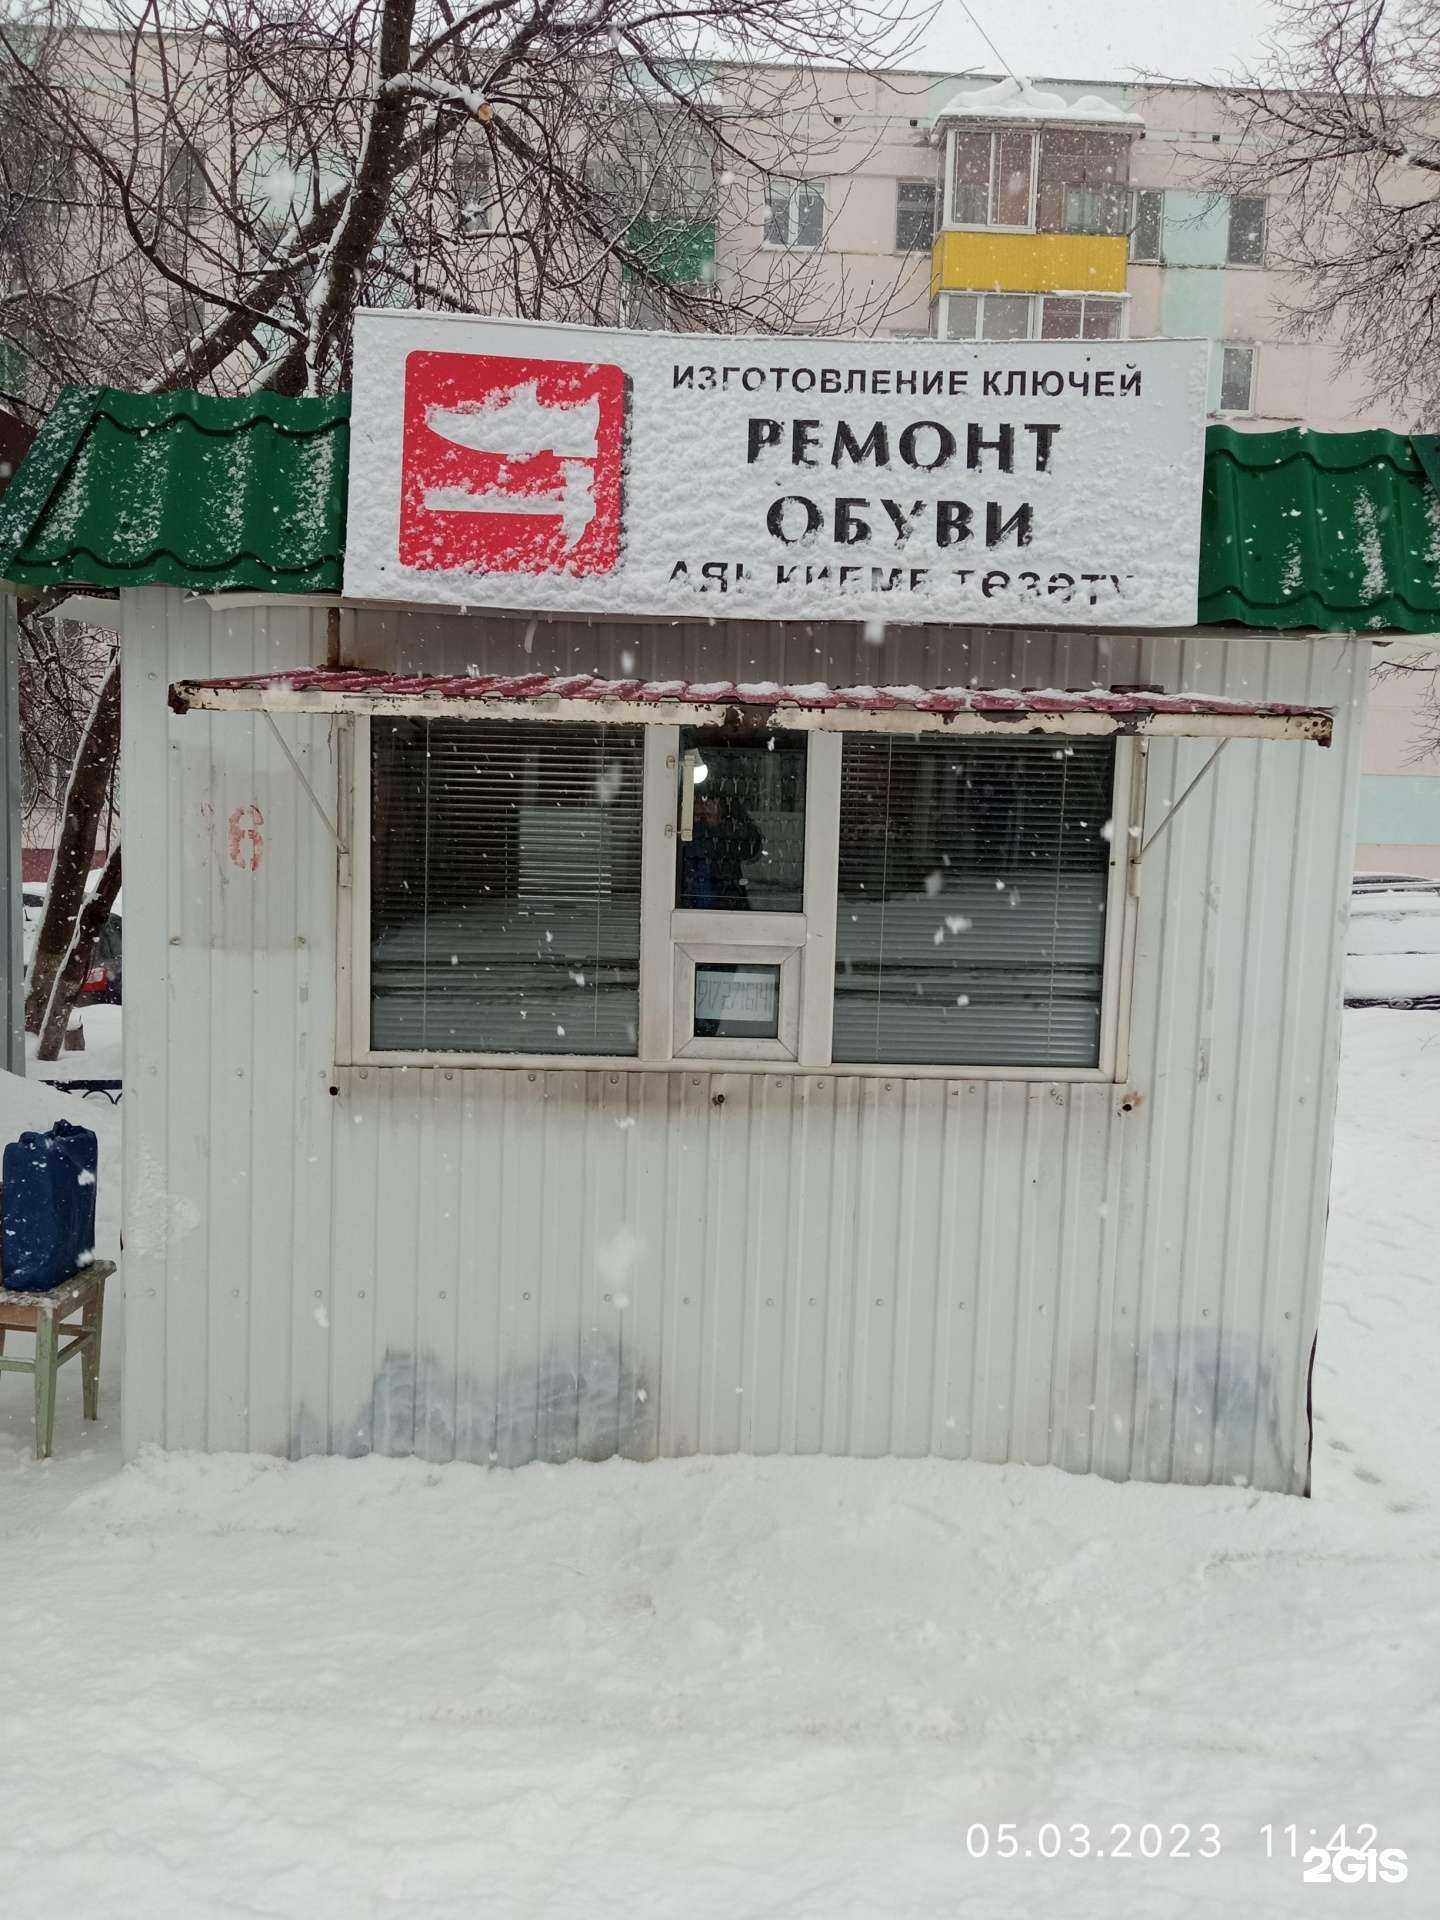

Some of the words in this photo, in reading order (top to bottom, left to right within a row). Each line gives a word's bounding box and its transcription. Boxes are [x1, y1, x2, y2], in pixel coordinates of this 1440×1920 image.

[672, 364, 969, 396] ИЗГОТОВЛЕНИЕ
[982, 363, 1143, 397] КЛЮЧЕЙ
[746, 417, 1062, 474] РЕМОНТ
[766, 494, 1035, 549] ОБУВИ
